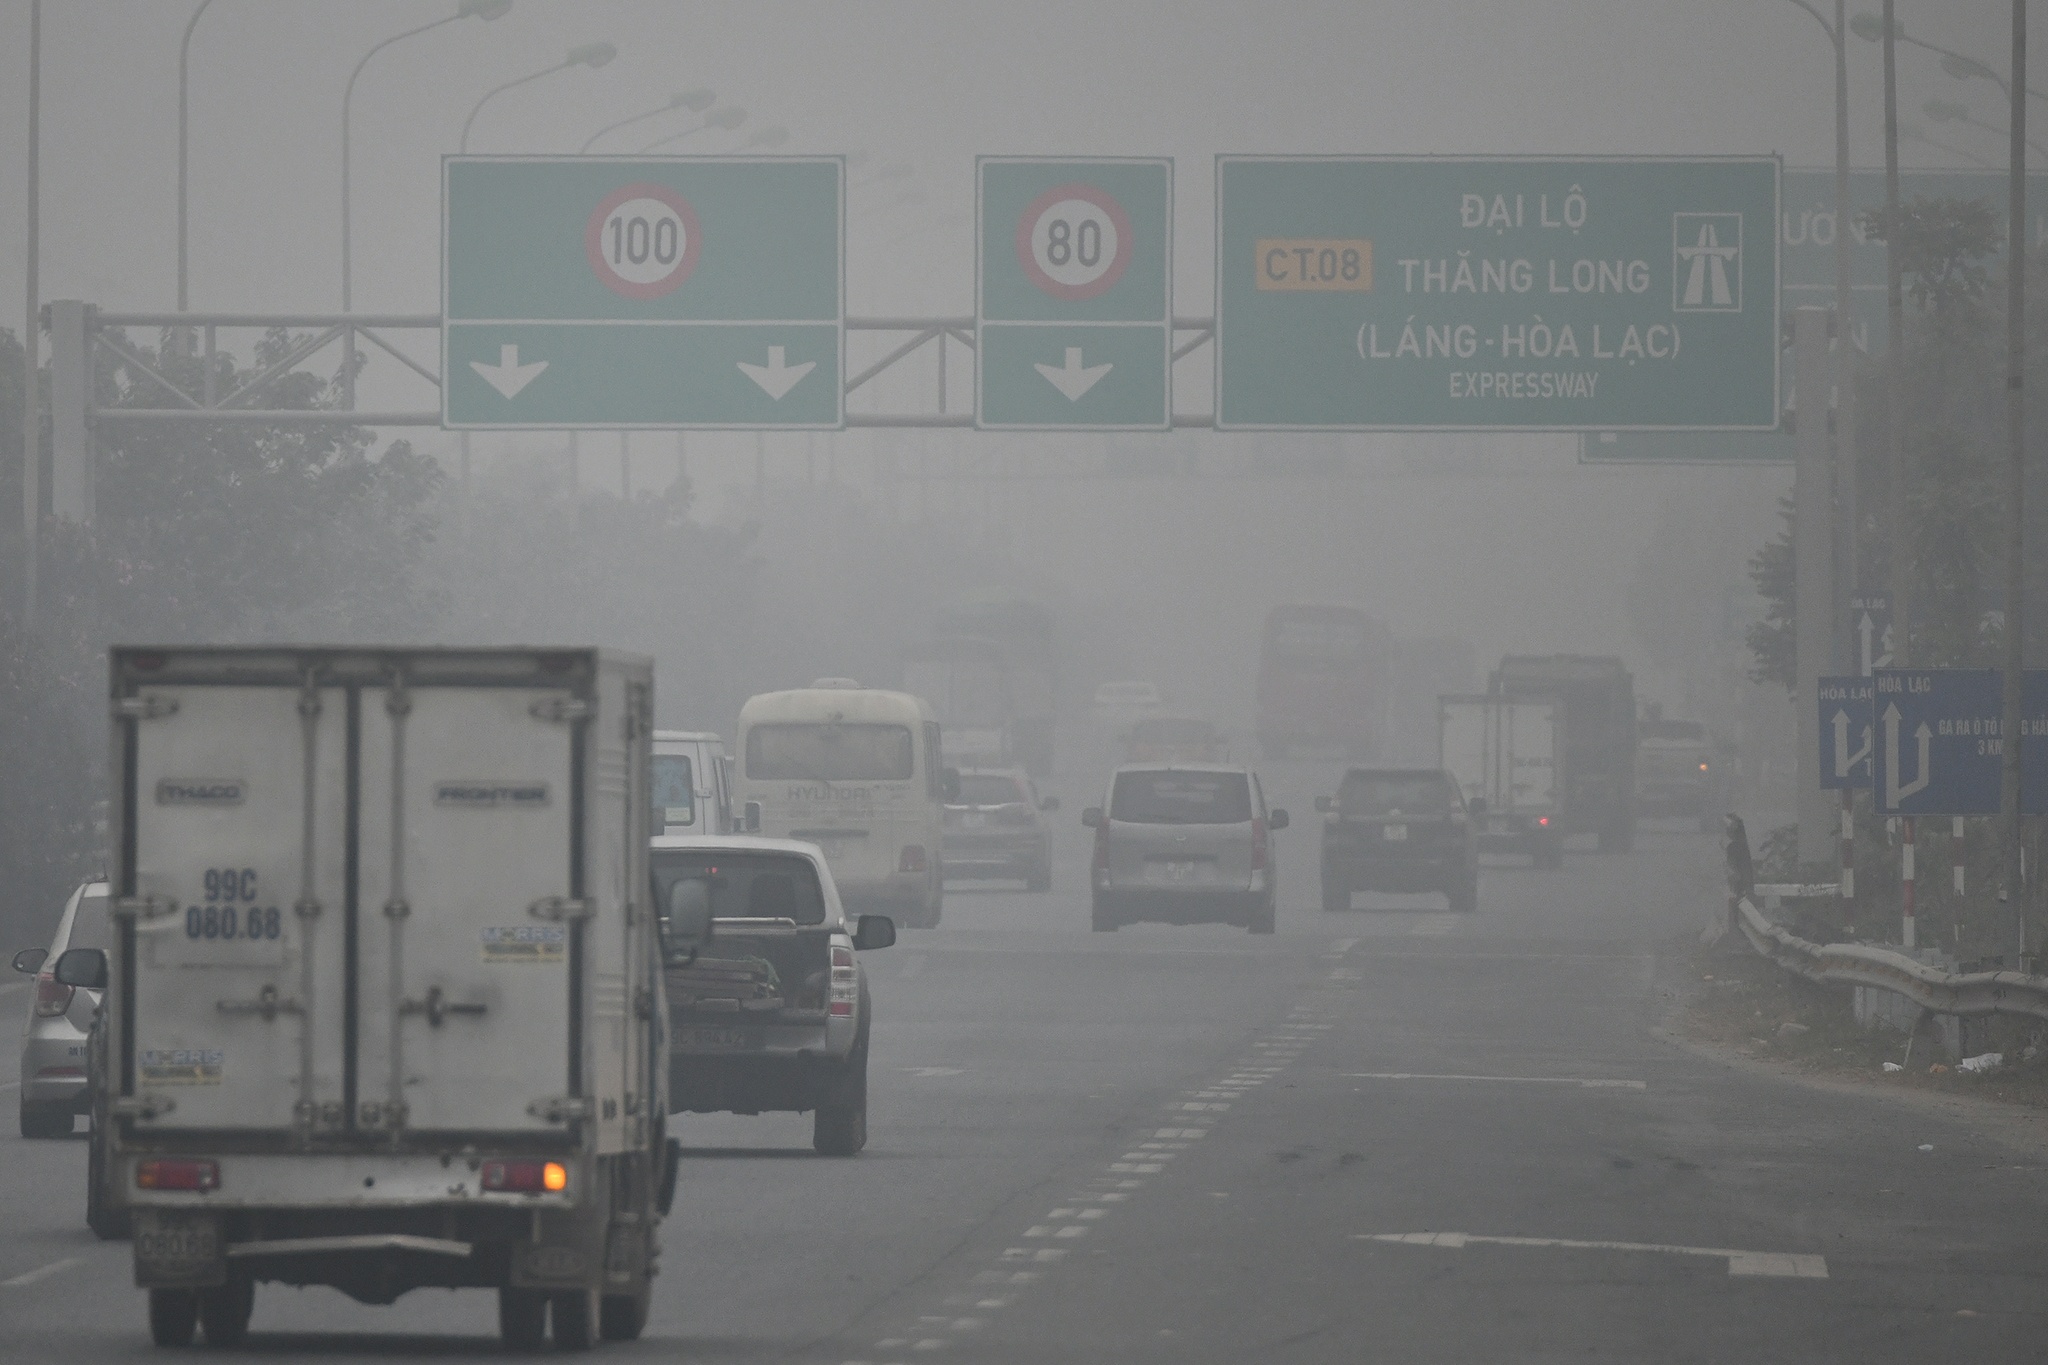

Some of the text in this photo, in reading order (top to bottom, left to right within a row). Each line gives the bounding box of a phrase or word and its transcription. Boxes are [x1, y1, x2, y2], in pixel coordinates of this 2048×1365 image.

[1460, 184, 1588, 235] ĐẠI LỘ
[610, 216, 678, 265] 100
[1047, 218, 1101, 267] 80
[1265, 247, 1361, 282] CT.08
[1398, 250, 1650, 293] THĂNG LONG
[1592, 323, 1681, 366] LẠC)
[1449, 371, 1599, 398] EXPRESSWAY
[204, 868, 257, 902] 99C
[186, 906, 281, 939] 080.68
